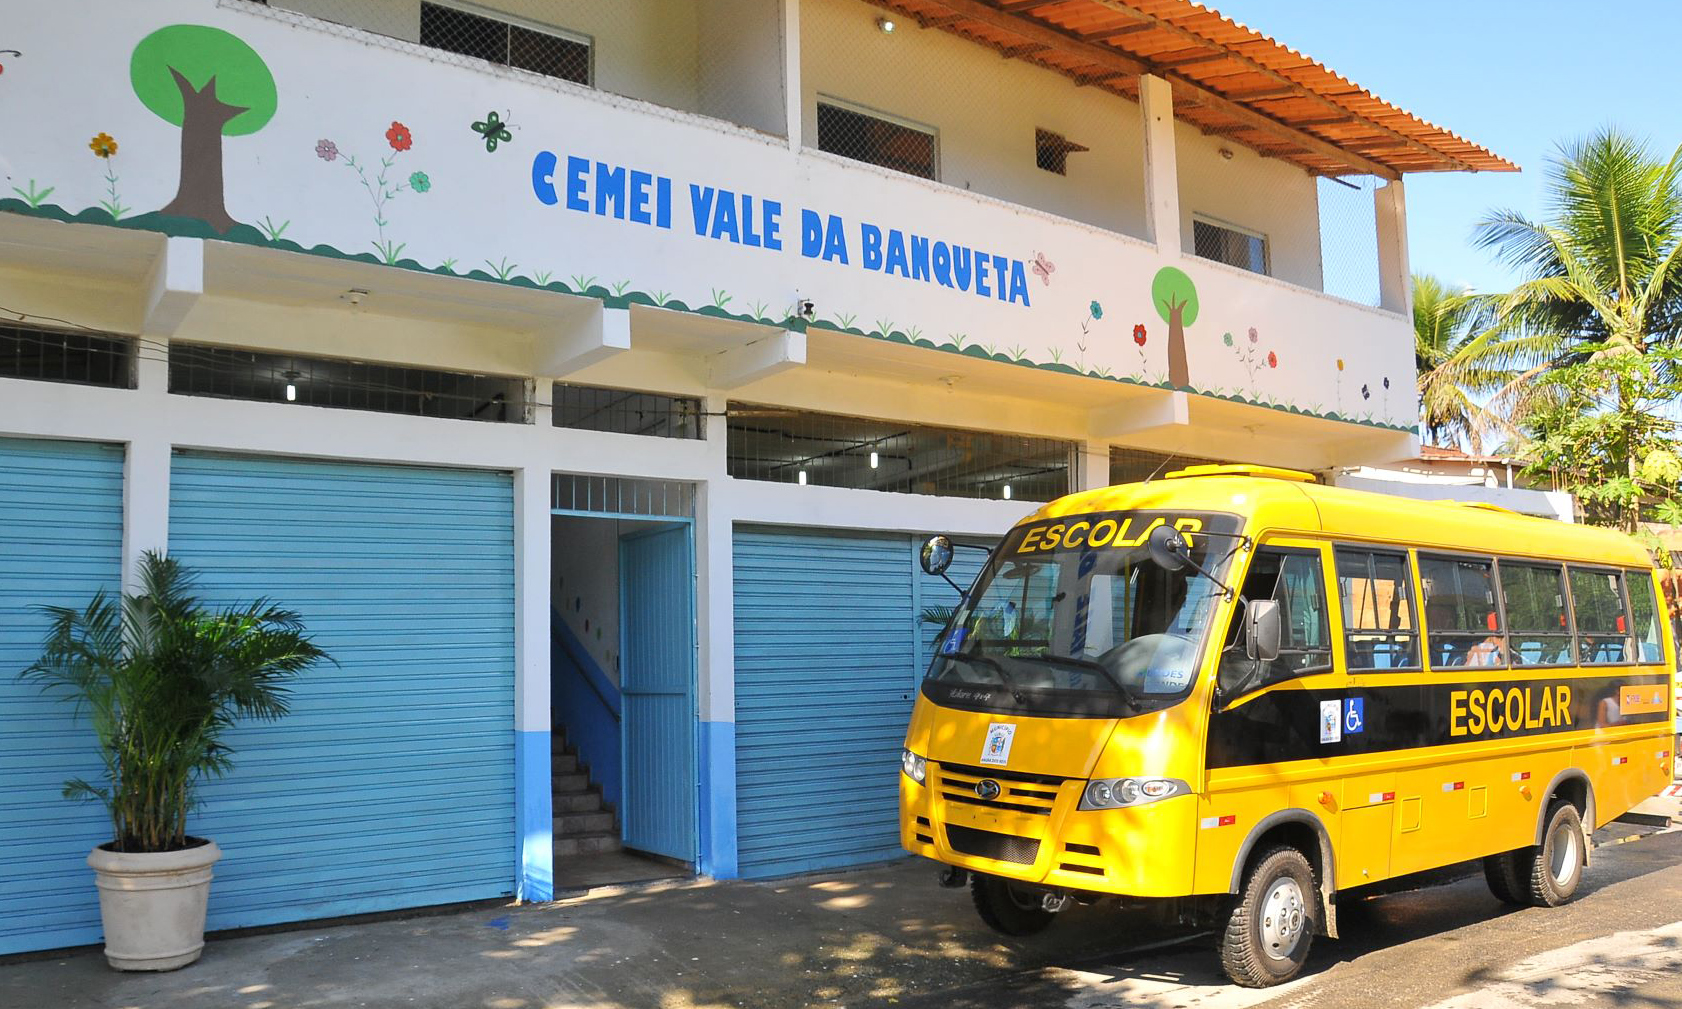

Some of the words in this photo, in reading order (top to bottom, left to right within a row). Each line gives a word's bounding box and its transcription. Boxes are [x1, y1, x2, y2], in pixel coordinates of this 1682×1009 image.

[532, 151, 672, 229] CEMEI
[689, 184, 782, 251] VALE
[801, 209, 849, 265] DA
[861, 223, 1030, 307] BANQUETA
[1450, 685, 1572, 737] ESCOLAR
